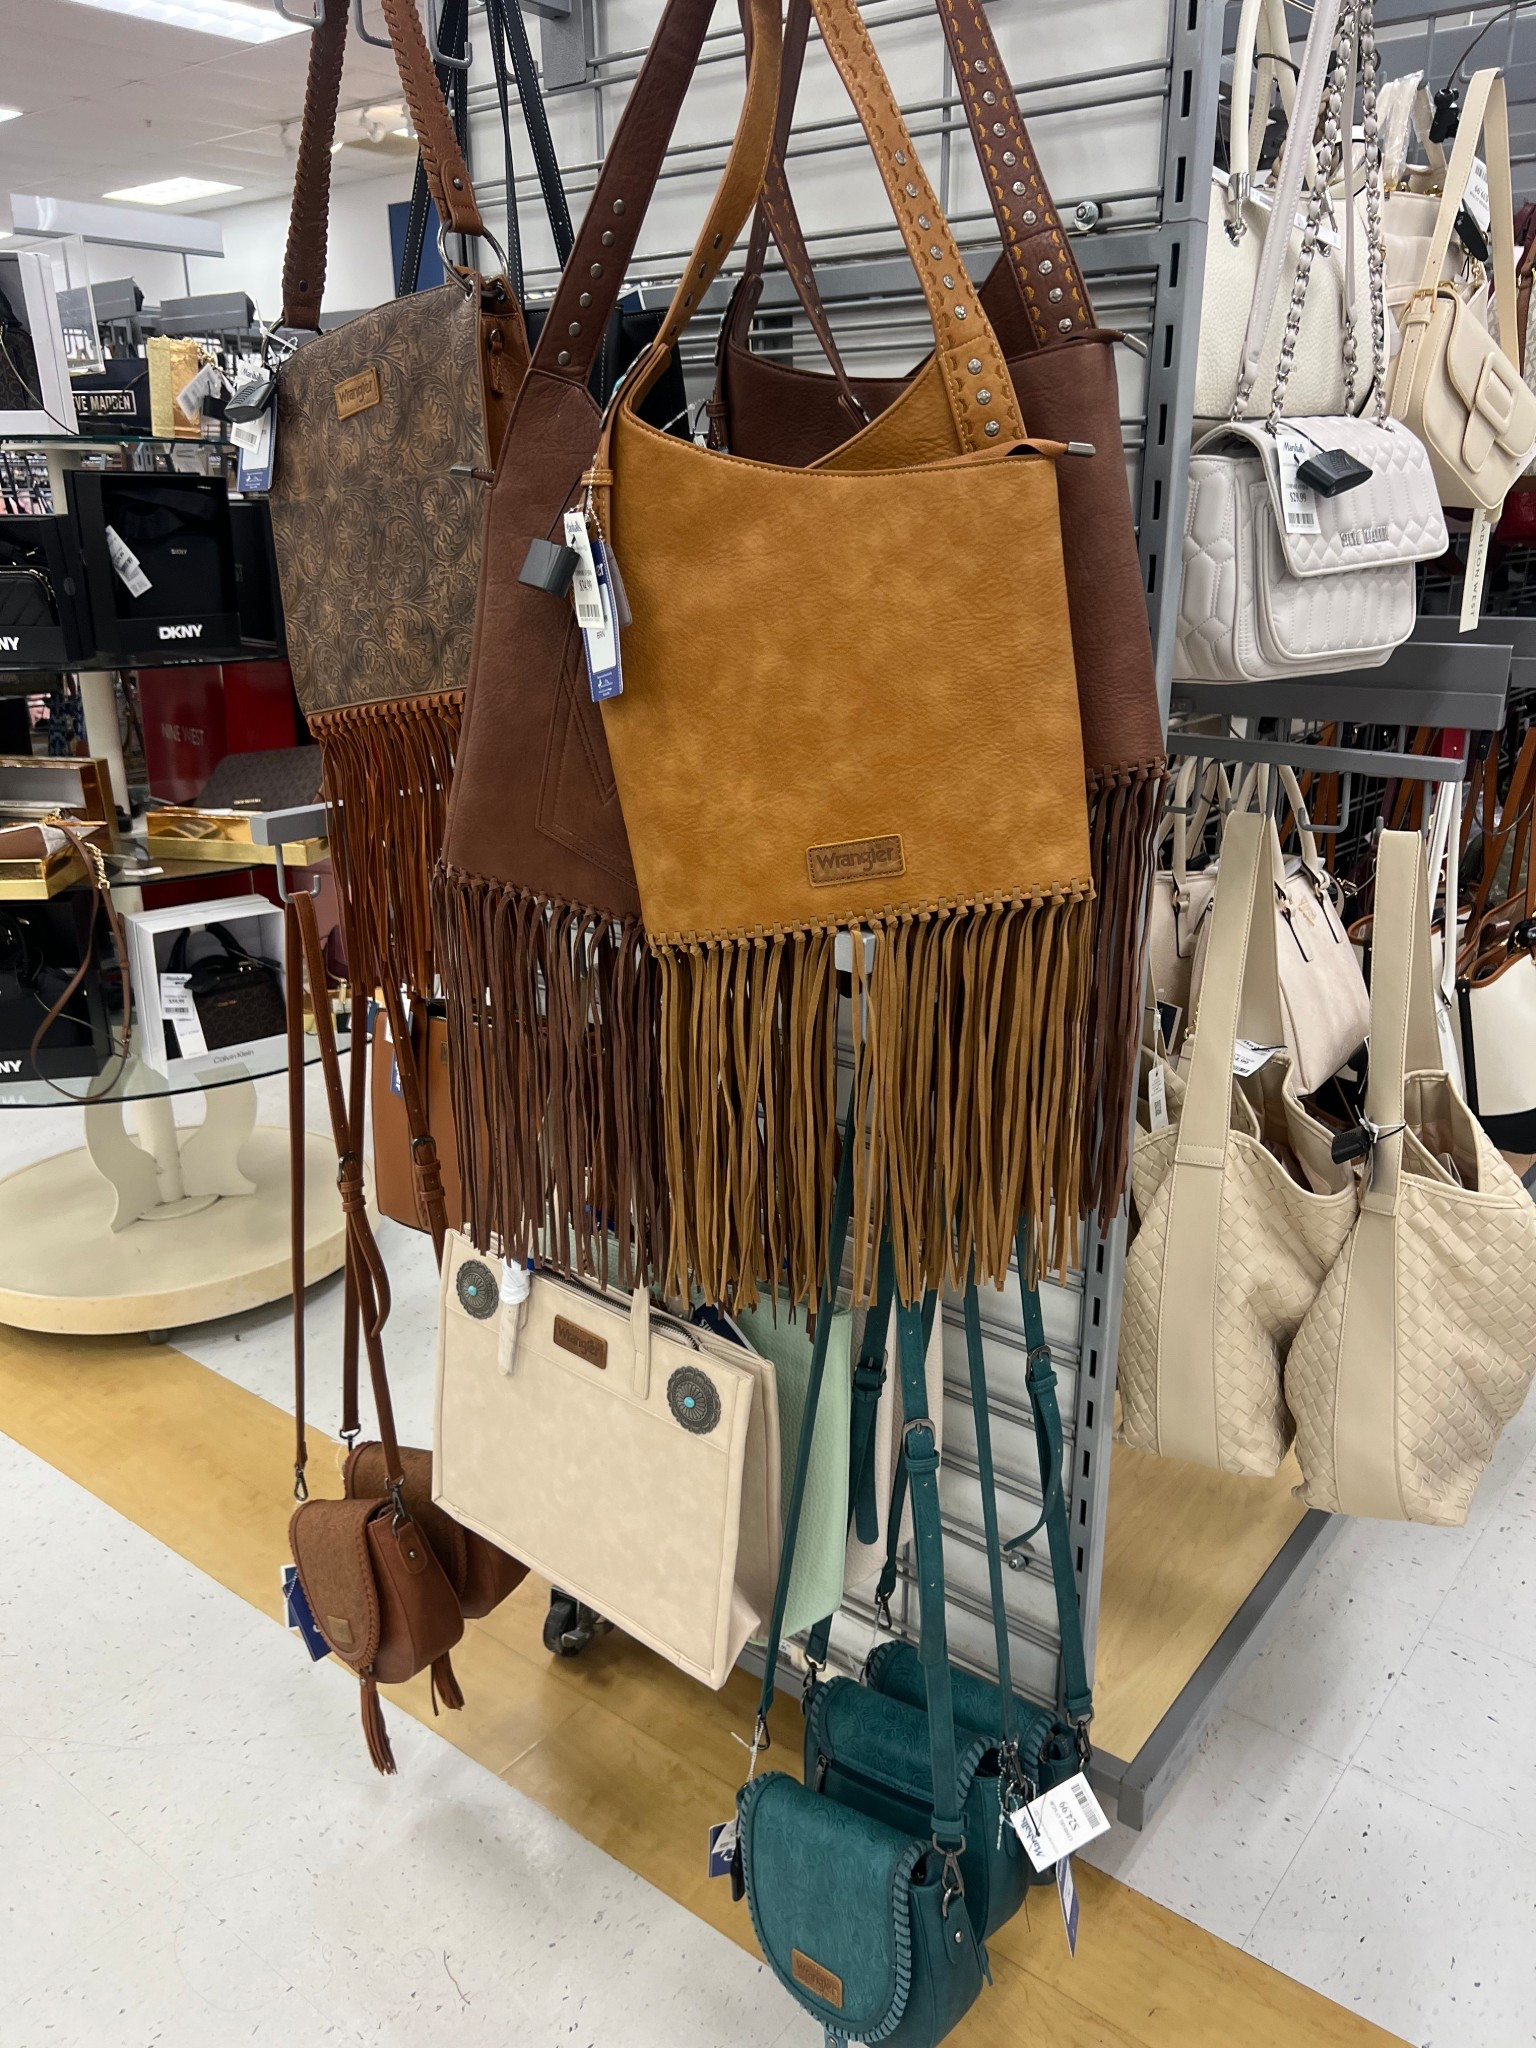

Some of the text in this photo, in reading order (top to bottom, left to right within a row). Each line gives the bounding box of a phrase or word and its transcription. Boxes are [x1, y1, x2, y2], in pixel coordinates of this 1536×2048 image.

[338, 380, 372, 404] Wrangler
[1283, 442, 1306, 454] Marshalls
[1469, 582, 1479, 616] WEST
[158, 624, 203, 640] DKNY
[816, 847, 894, 872] Wrangler
[213, 1049, 255, 1064] Calvin Klein
[558, 1324, 602, 1358] Wrangler
[1059, 1801, 1080, 1831] $24.99
[1020, 1816, 1045, 1857] Marshalls
